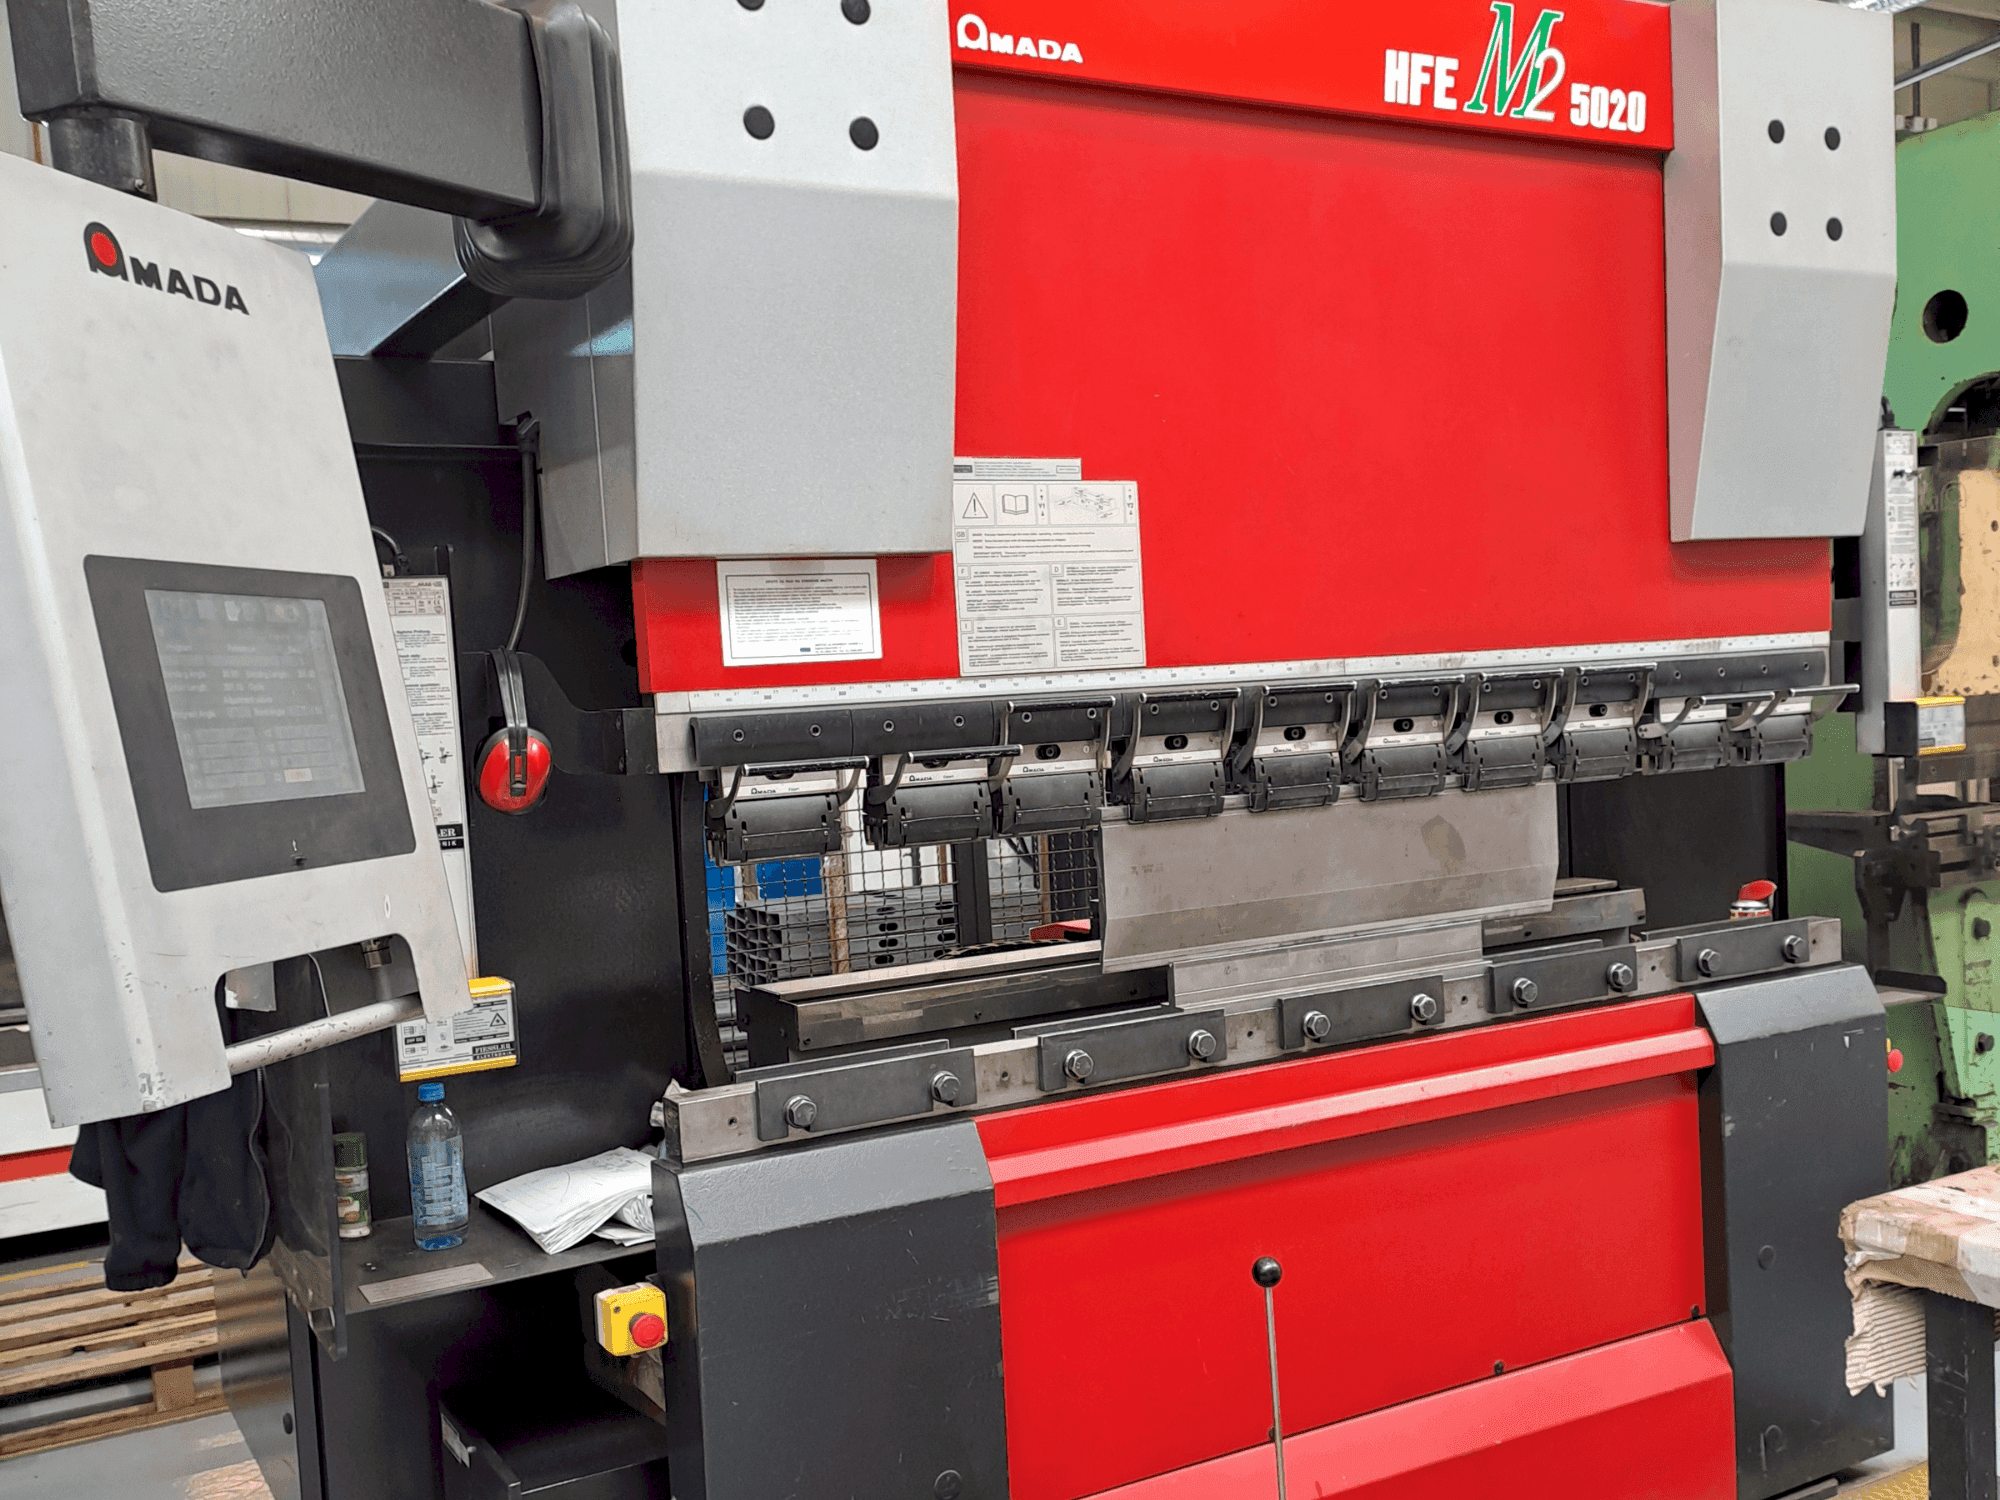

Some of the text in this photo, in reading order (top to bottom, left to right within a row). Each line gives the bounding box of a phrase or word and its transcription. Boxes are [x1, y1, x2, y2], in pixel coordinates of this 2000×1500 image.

[956, 13, 1084, 64] AMADA
[1384, 48, 1460, 112] HFE
[1569, 83, 1648, 134] 5020
[83, 221, 250, 316] AMADA
[751, 787, 777, 795] AMADA
